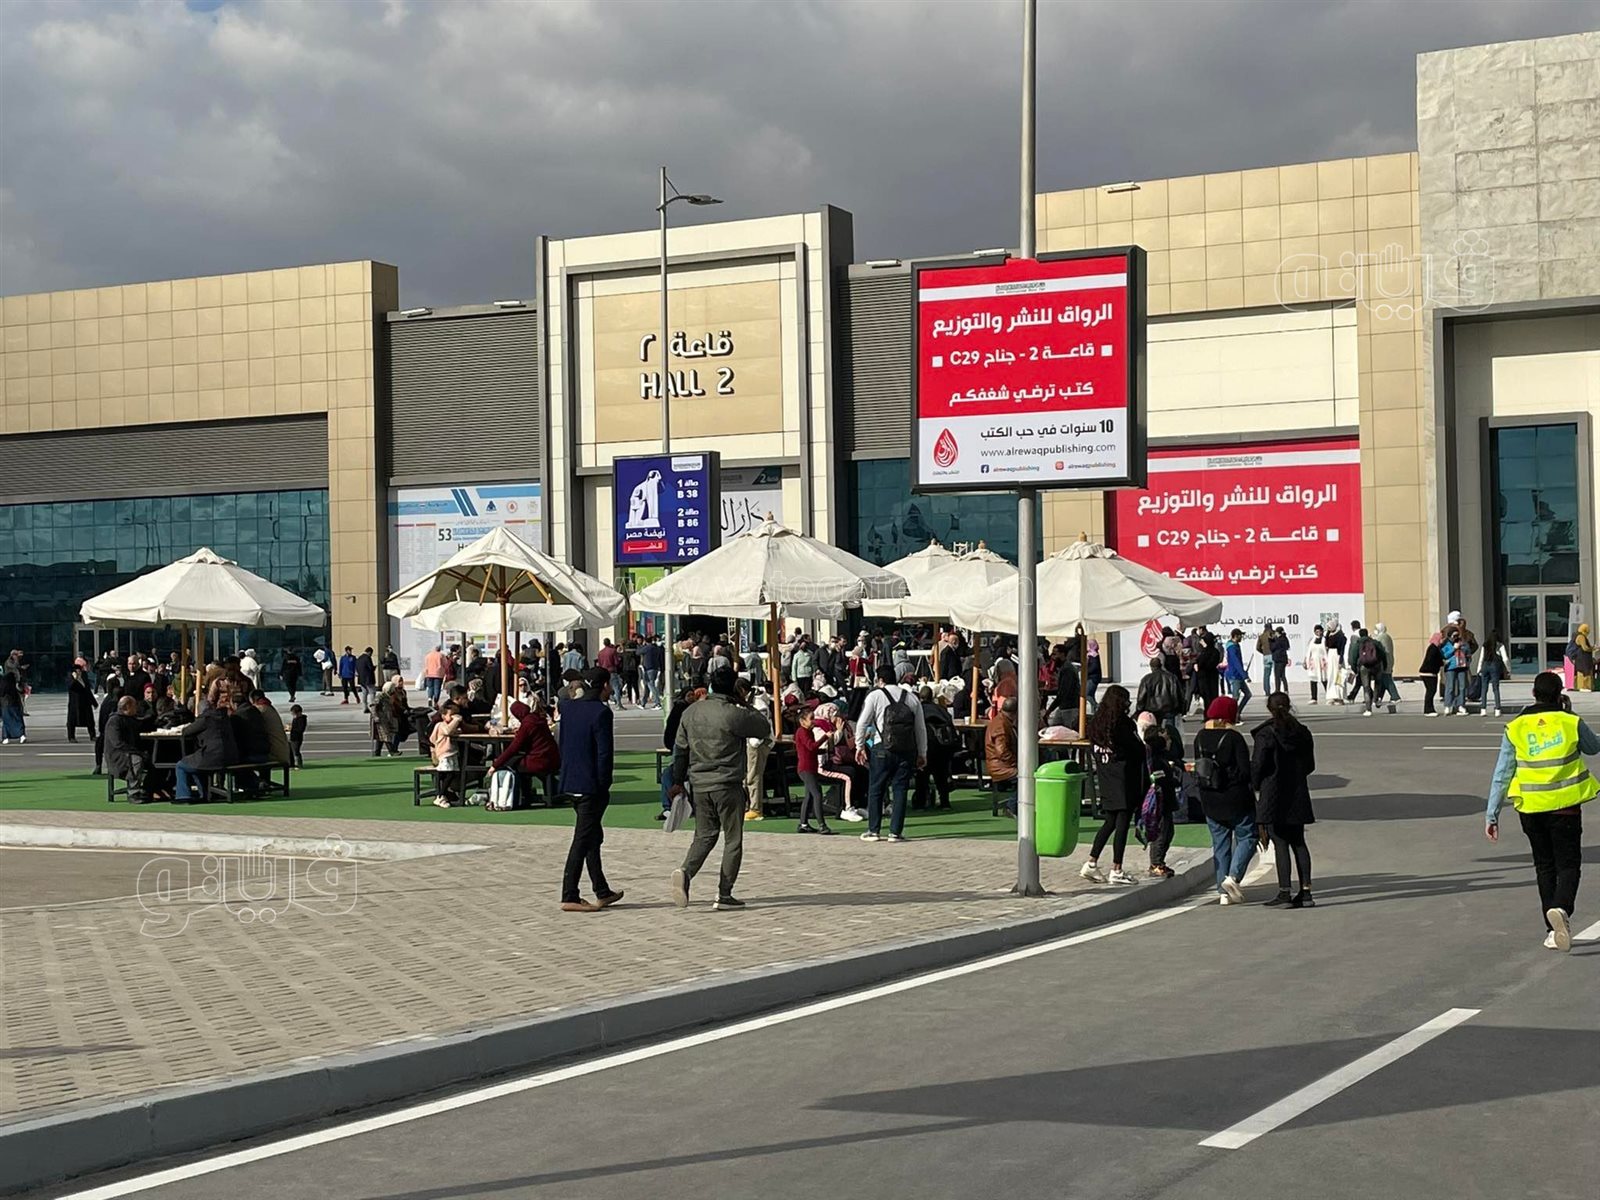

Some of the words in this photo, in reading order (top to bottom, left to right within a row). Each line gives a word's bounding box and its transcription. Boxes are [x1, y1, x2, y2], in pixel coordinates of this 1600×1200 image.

[1006, 307, 1053, 333] للنشر
[1057, 303, 1113, 327] الرواق
[932, 313, 1002, 338] والتوزيع
[669, 331, 735, 358] قاعة
[950, 351, 980, 365] C29
[983, 349, 1016, 368] جناح
[1029, 346, 1039, 361] 2
[640, 368, 706, 399] HALL
[716, 367, 735, 395] 2
[1058, 382, 1094, 398] كتب
[949, 385, 1010, 407] شغفكم
[1013, 384, 1056, 402] ترضي
[980, 427, 1013, 440] الكتب
[1016, 428, 1034, 439] حب
[1037, 424, 1057, 438] في
[1059, 423, 1097, 437] سنوات
[1099, 419, 1114, 433] 10
[980, 443, 1116, 457] www.alrewaqpublishing.com
[677, 479, 683, 488] 1
[677, 490, 684, 499] B
[686, 489, 698, 498] 38
[1219, 485, 1270, 512] للنشر
[1275, 484, 1337, 509] الرواق
[1137, 489, 1214, 516] والتوزيع
[677, 508, 684, 517] 2
[678, 519, 685, 528] B
[687, 518, 699, 527] 86
[438, 528, 452, 541] 53
[678, 537, 684, 546] 5
[1157, 531, 1190, 546] C29
[1194, 530, 1230, 549] جناح
[1245, 528, 1256, 543] 2
[677, 548, 685, 557] A
[687, 547, 699, 556] 26
[1228, 565, 1275, 584] ترضي
[1279, 564, 1319, 583] كتب
[1220, 617, 1236, 629] حب
[1238, 616, 1253, 627] في
[1287, 613, 1300, 625] 10
